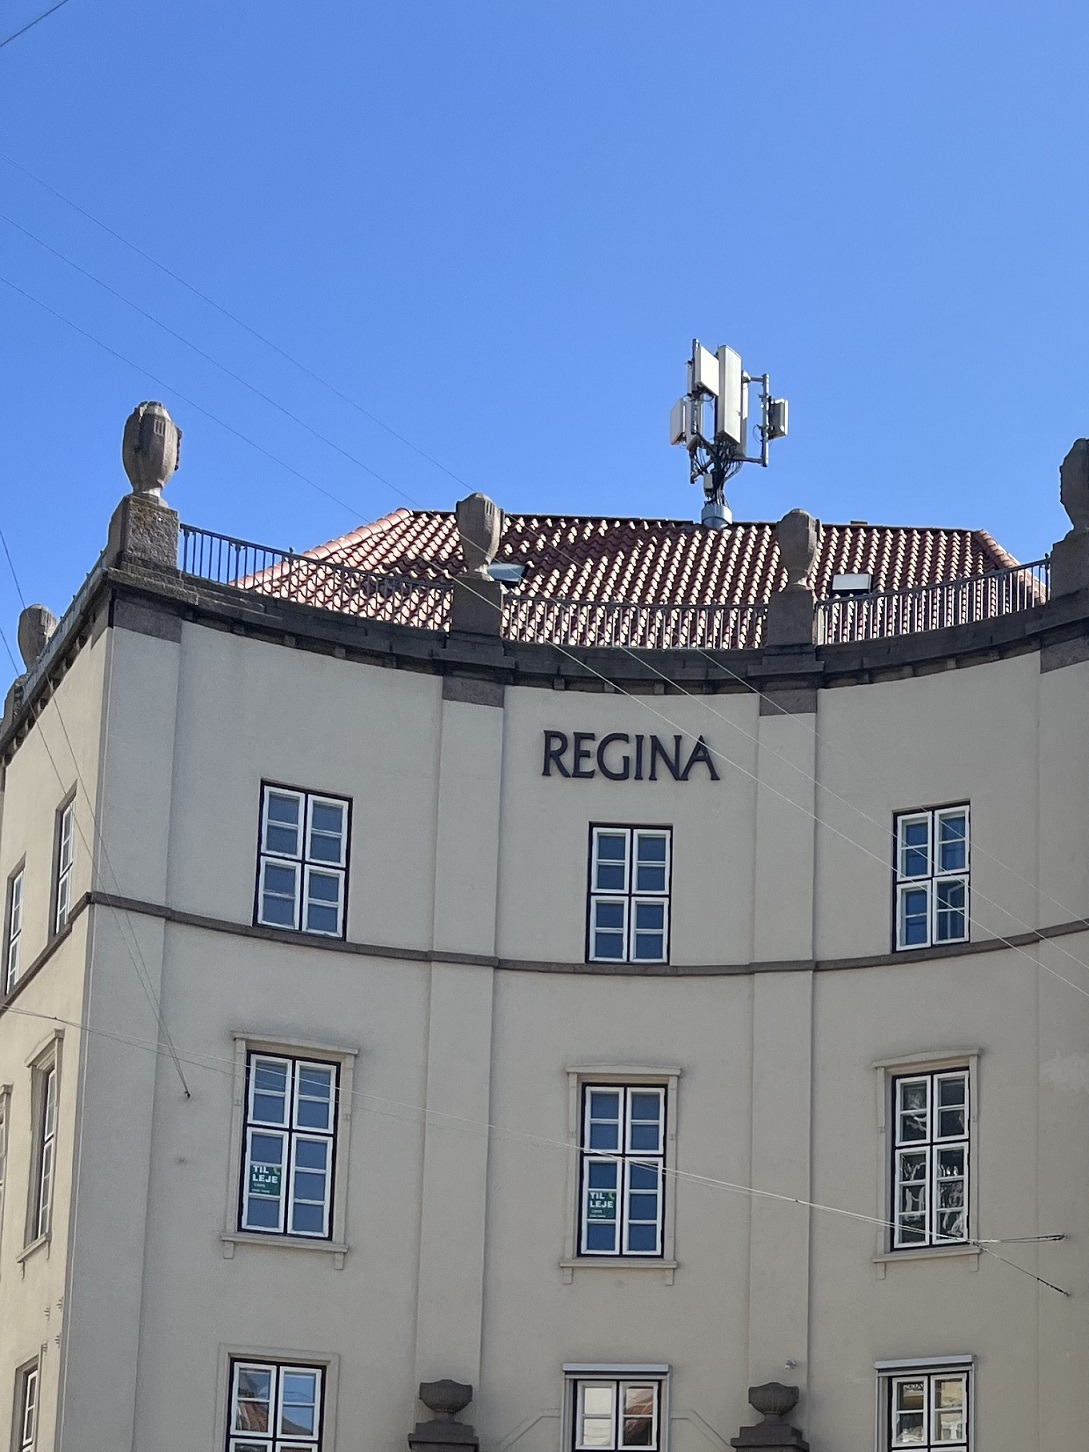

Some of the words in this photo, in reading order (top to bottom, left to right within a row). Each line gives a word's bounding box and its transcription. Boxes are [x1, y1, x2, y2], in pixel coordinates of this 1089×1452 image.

[542, 730, 720, 781] REGINA
[253, 1165, 269, 1174] TIL
[252, 1174, 278, 1184] LEJE
[590, 1192, 605, 1200] TIL
[589, 1200, 614, 1208] LEJE
